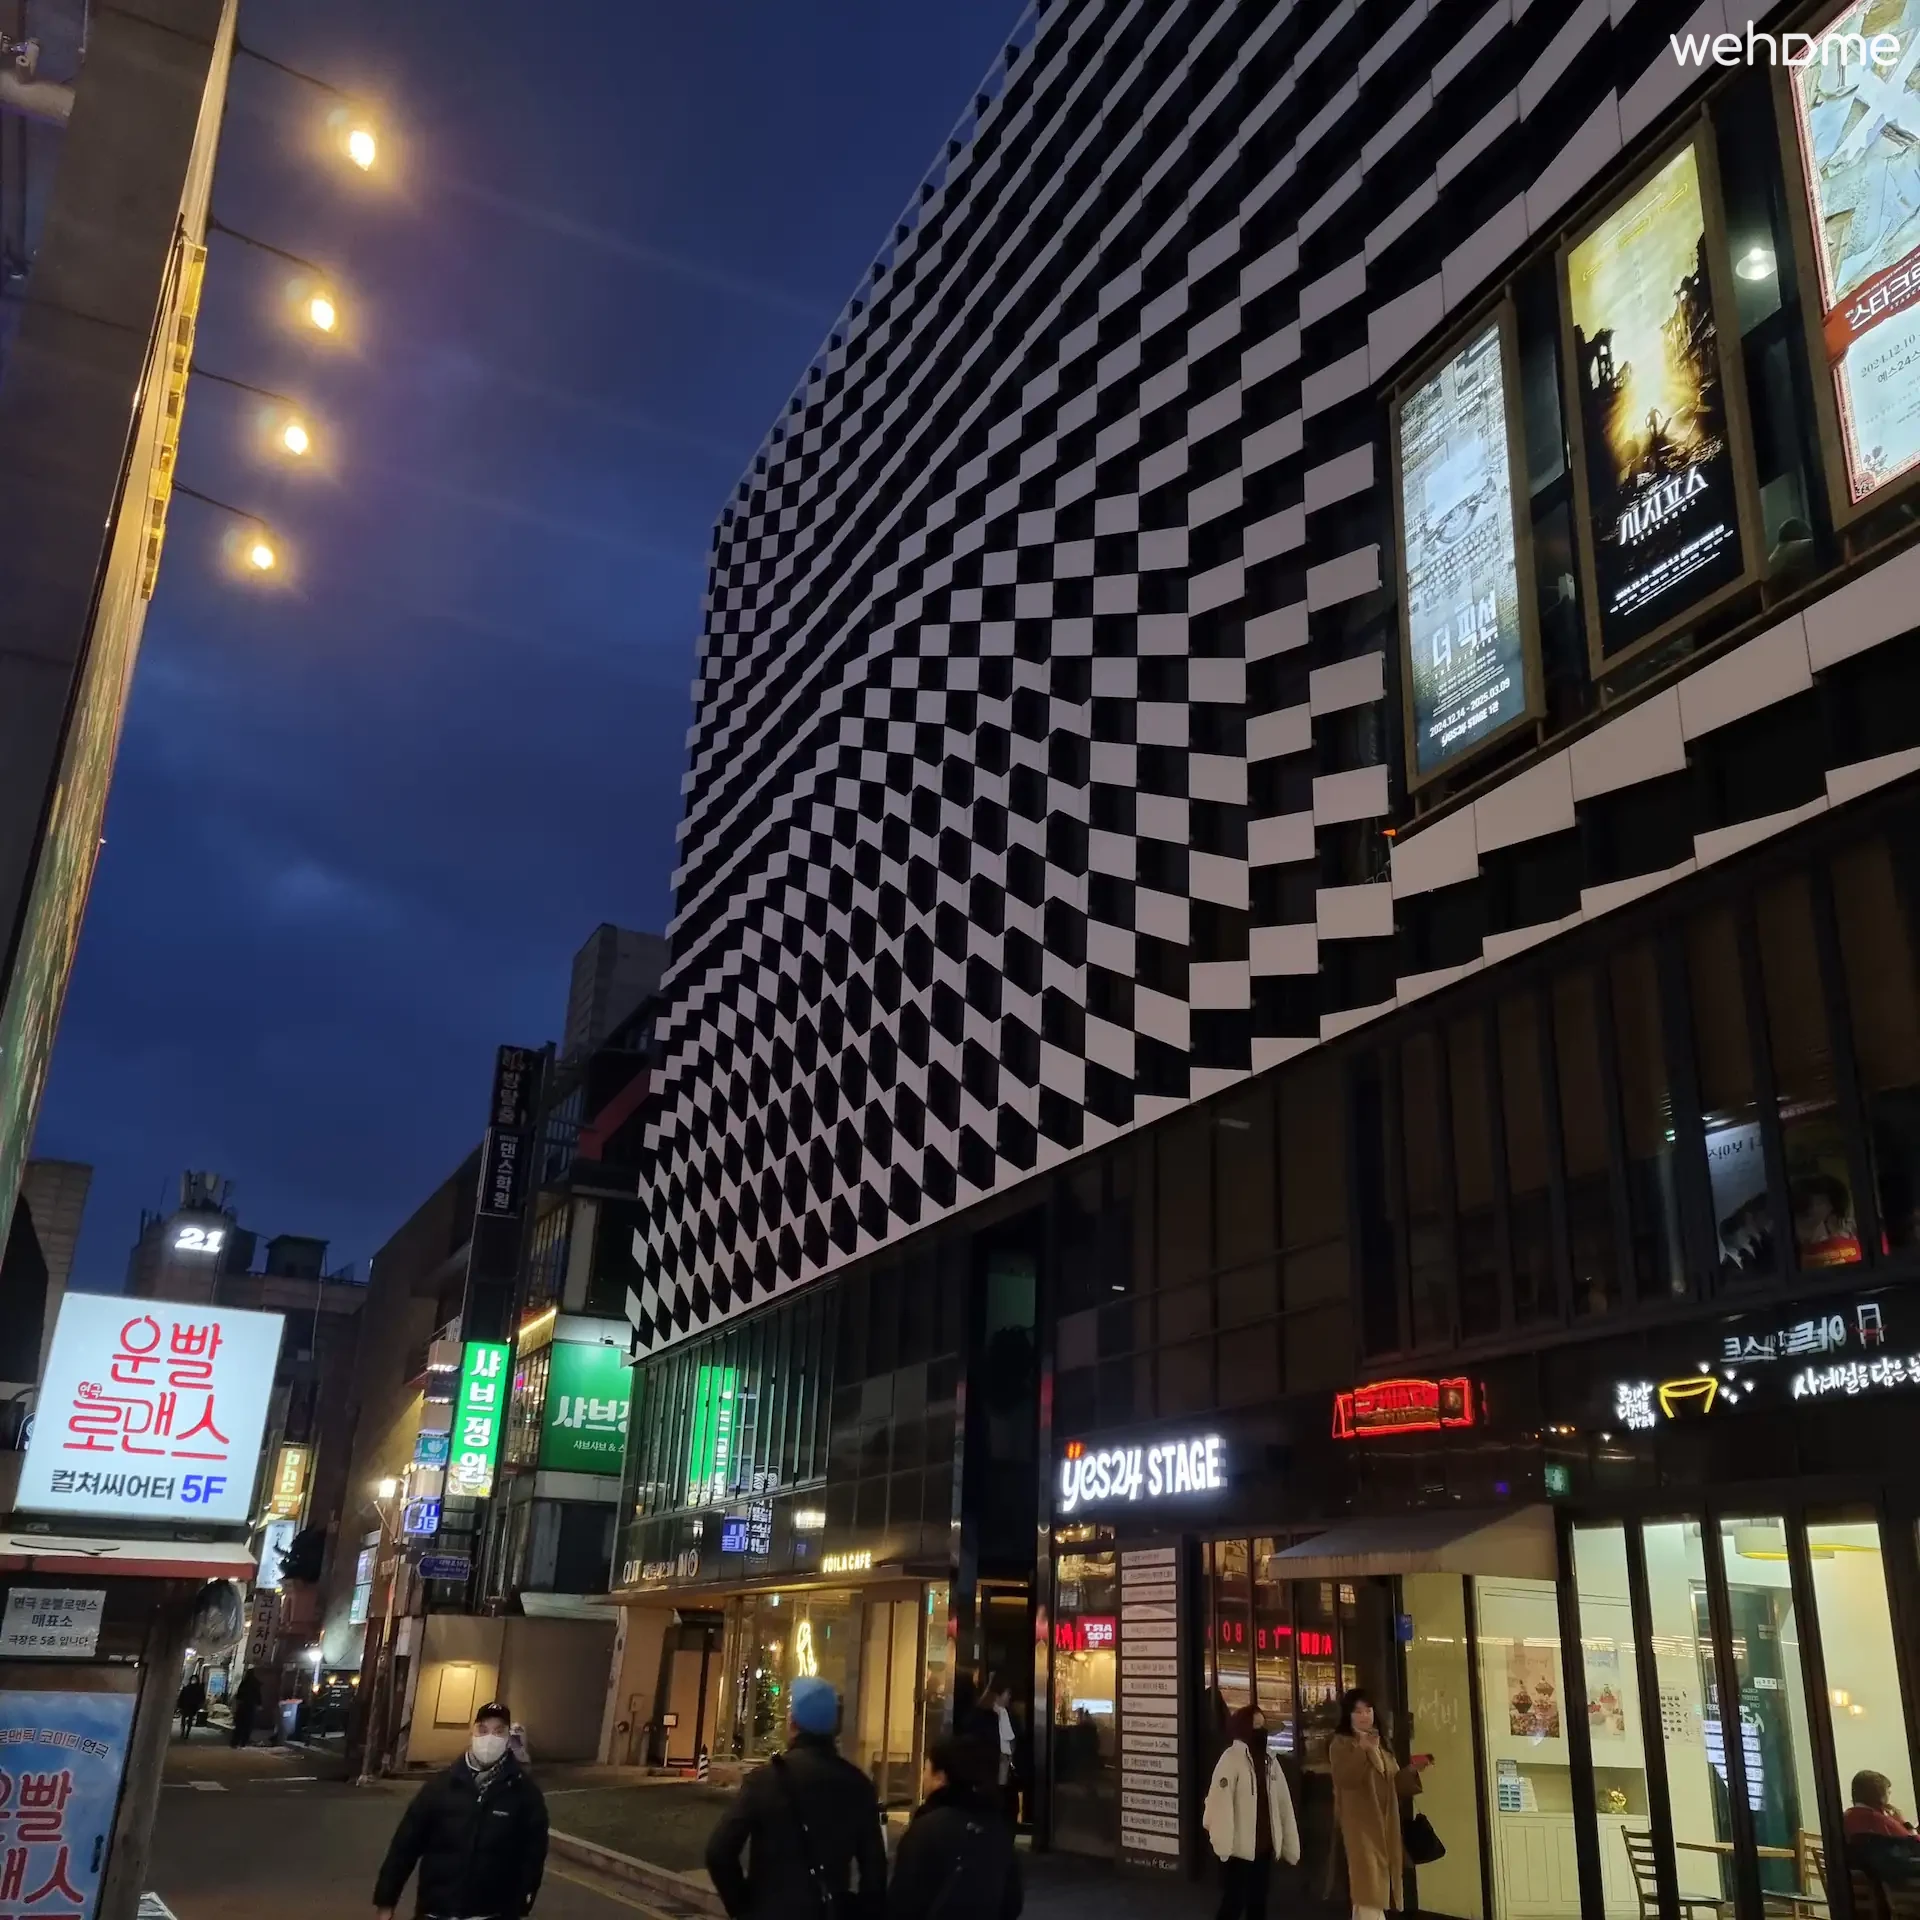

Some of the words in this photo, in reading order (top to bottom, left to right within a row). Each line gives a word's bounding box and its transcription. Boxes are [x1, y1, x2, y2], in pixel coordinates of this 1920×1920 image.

[1432, 623, 1452, 667] 더
[1457, 590, 1499, 650] 픽션
[1429, 704, 1466, 738] 2024.12.14
[1470, 677, 1511, 712] 2025.03.09
[174, 1227, 223, 1254] 21
[111, 1315, 223, 1390] 운빨
[1793, 1362, 1870, 1400] 사계절을
[1870, 1356, 1908, 1388] 담은
[63, 1391, 230, 1460] 로맨스
[459, 1347, 502, 1484] 샤브정원
[50, 1469, 176, 1500] 컬쳐씨어터
[180, 1474, 227, 1504] 5F
[280, 1450, 301, 1494] bhc
[1147, 1434, 1222, 1497] STAGE
[848, 1551, 872, 1570] CAFE
[9, 1634, 37, 1646] 극장은
[31, 1613, 72, 1628] 매표소
[82, 1738, 110, 1760] 연극
[0, 1769, 73, 1843] 빨
